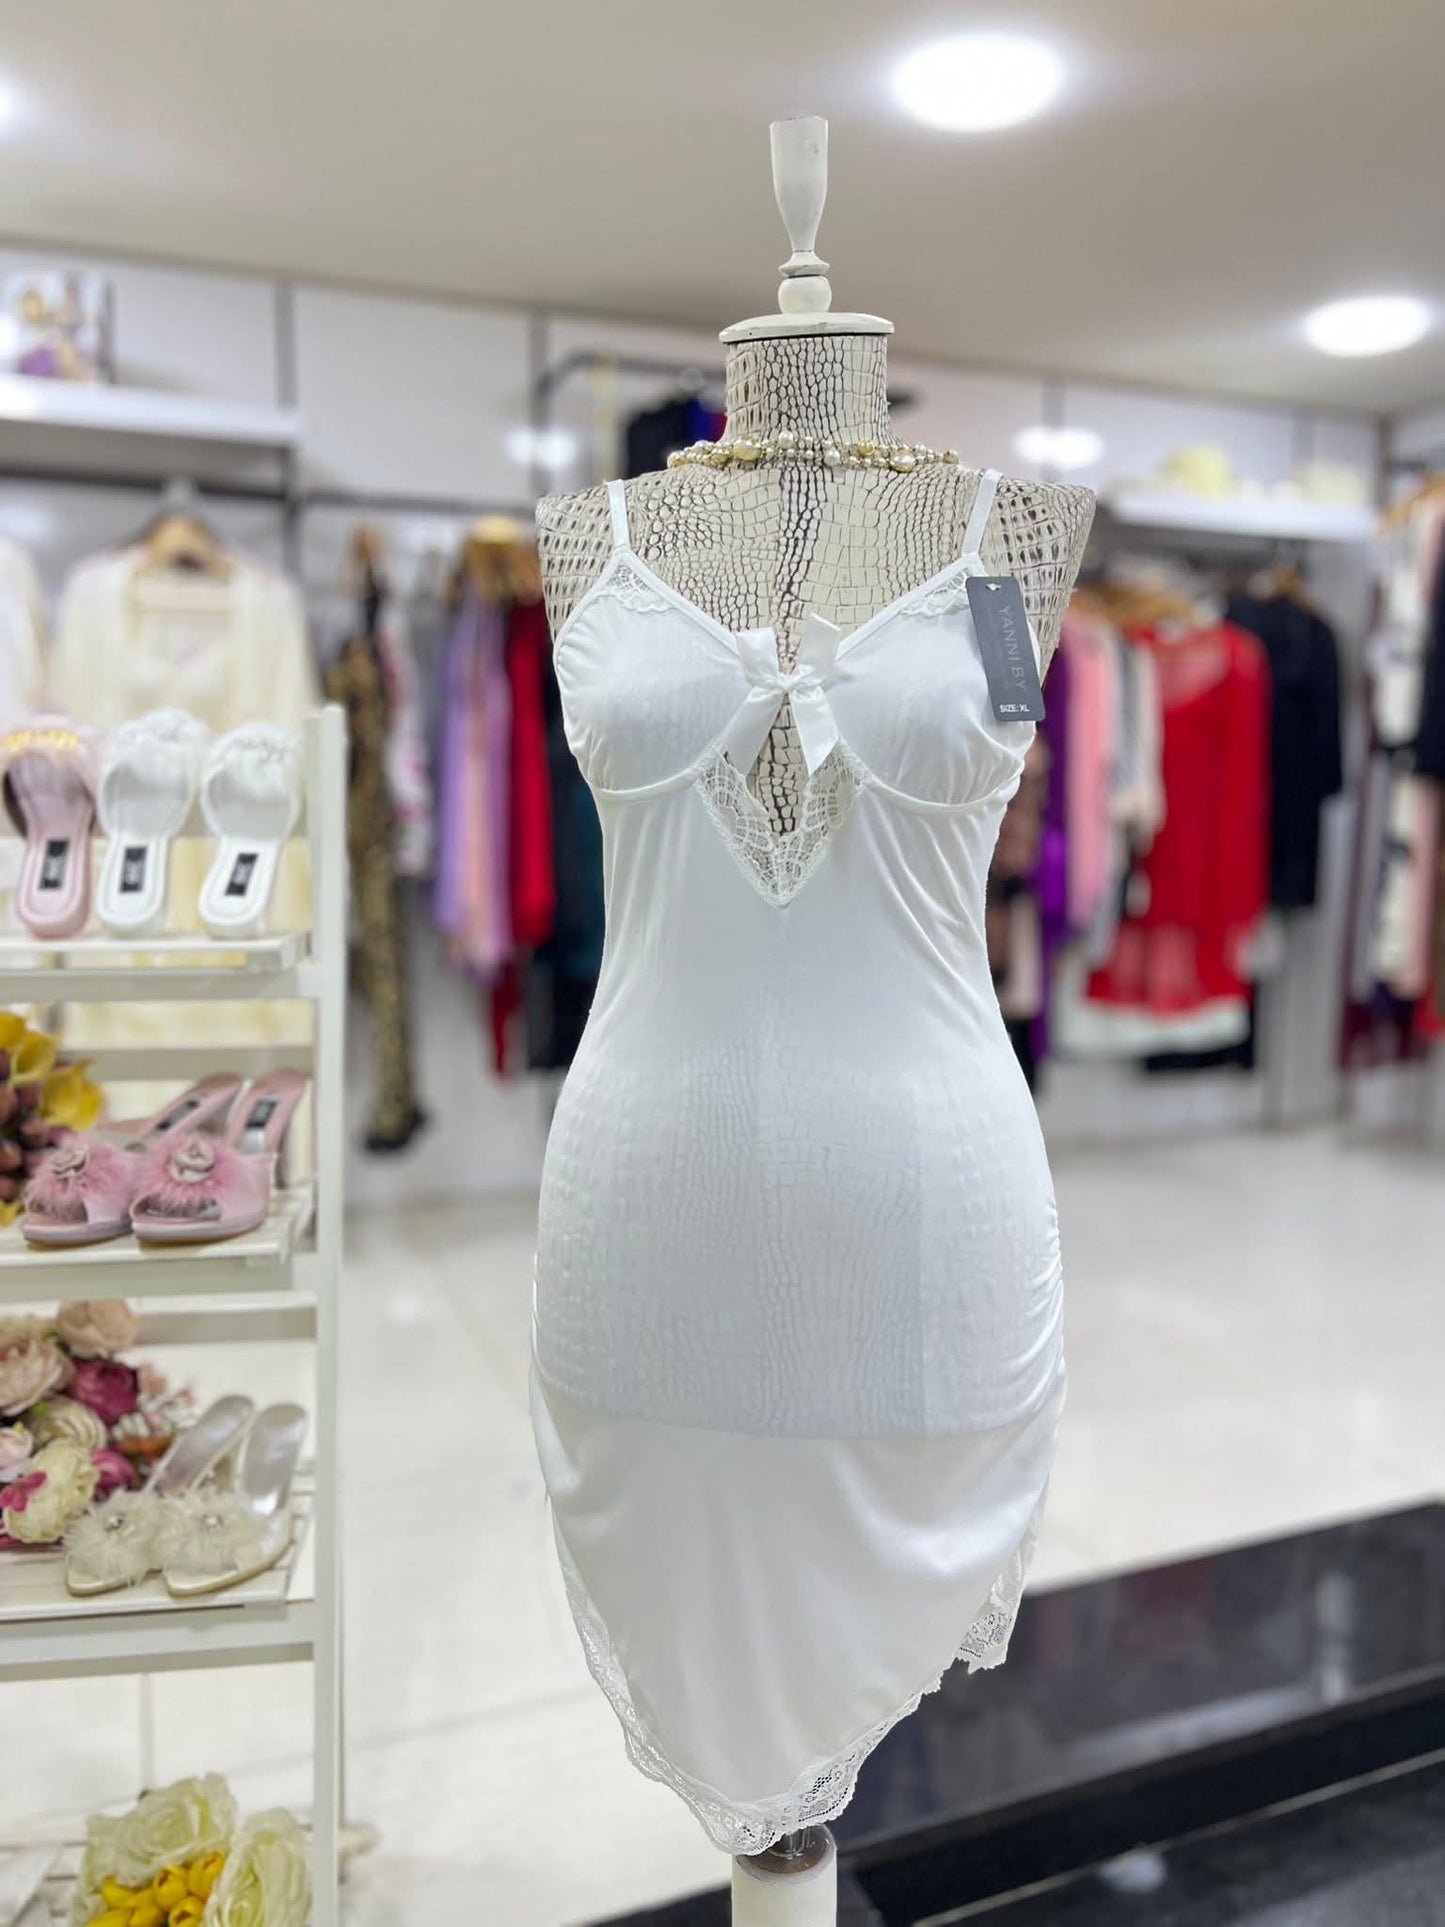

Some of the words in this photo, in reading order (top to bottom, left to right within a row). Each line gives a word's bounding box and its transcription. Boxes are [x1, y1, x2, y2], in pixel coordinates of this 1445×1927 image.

[998, 605, 1020, 660] YANNI
[1011, 666, 1026, 690] BY
[1000, 704, 1019, 712] SIZE:
[1020, 703, 1030, 712] XL
